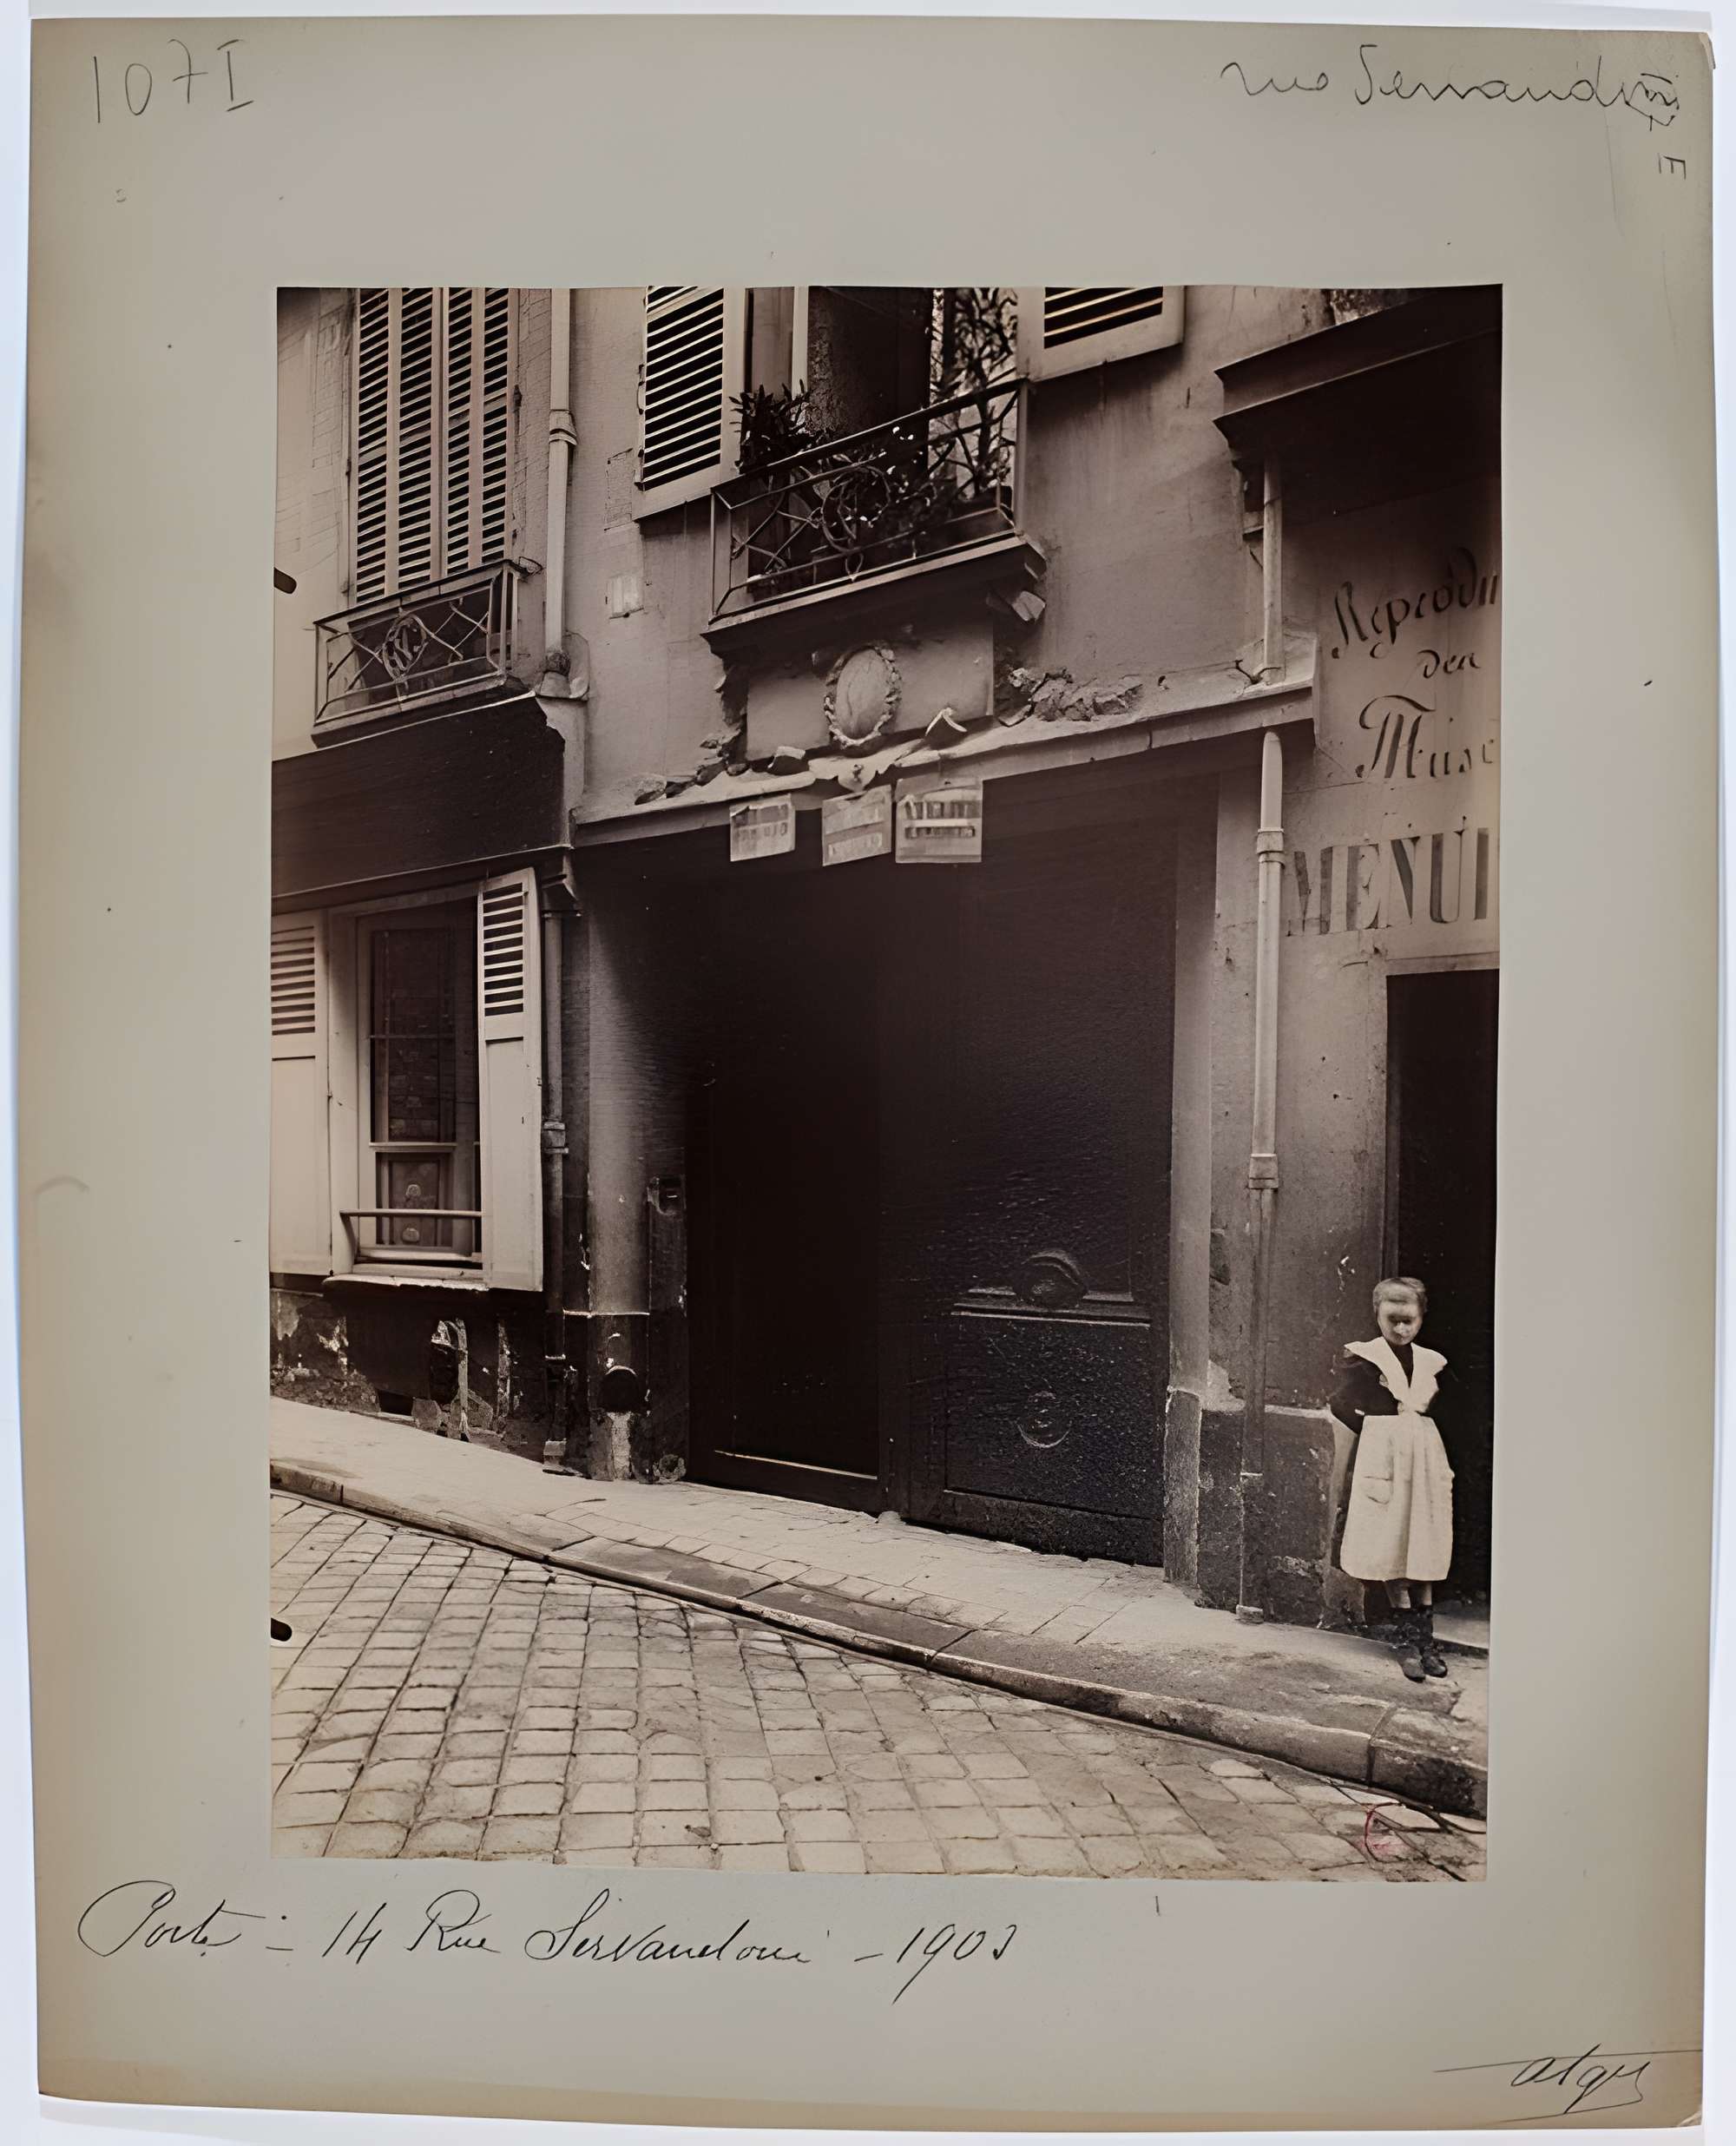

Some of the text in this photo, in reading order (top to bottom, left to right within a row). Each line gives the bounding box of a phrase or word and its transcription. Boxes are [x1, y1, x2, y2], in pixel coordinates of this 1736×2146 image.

[1286, 826, 1490, 938] MENUI
[321, 1902, 387, 1965] 14
[404, 1889, 503, 1954] Rue
